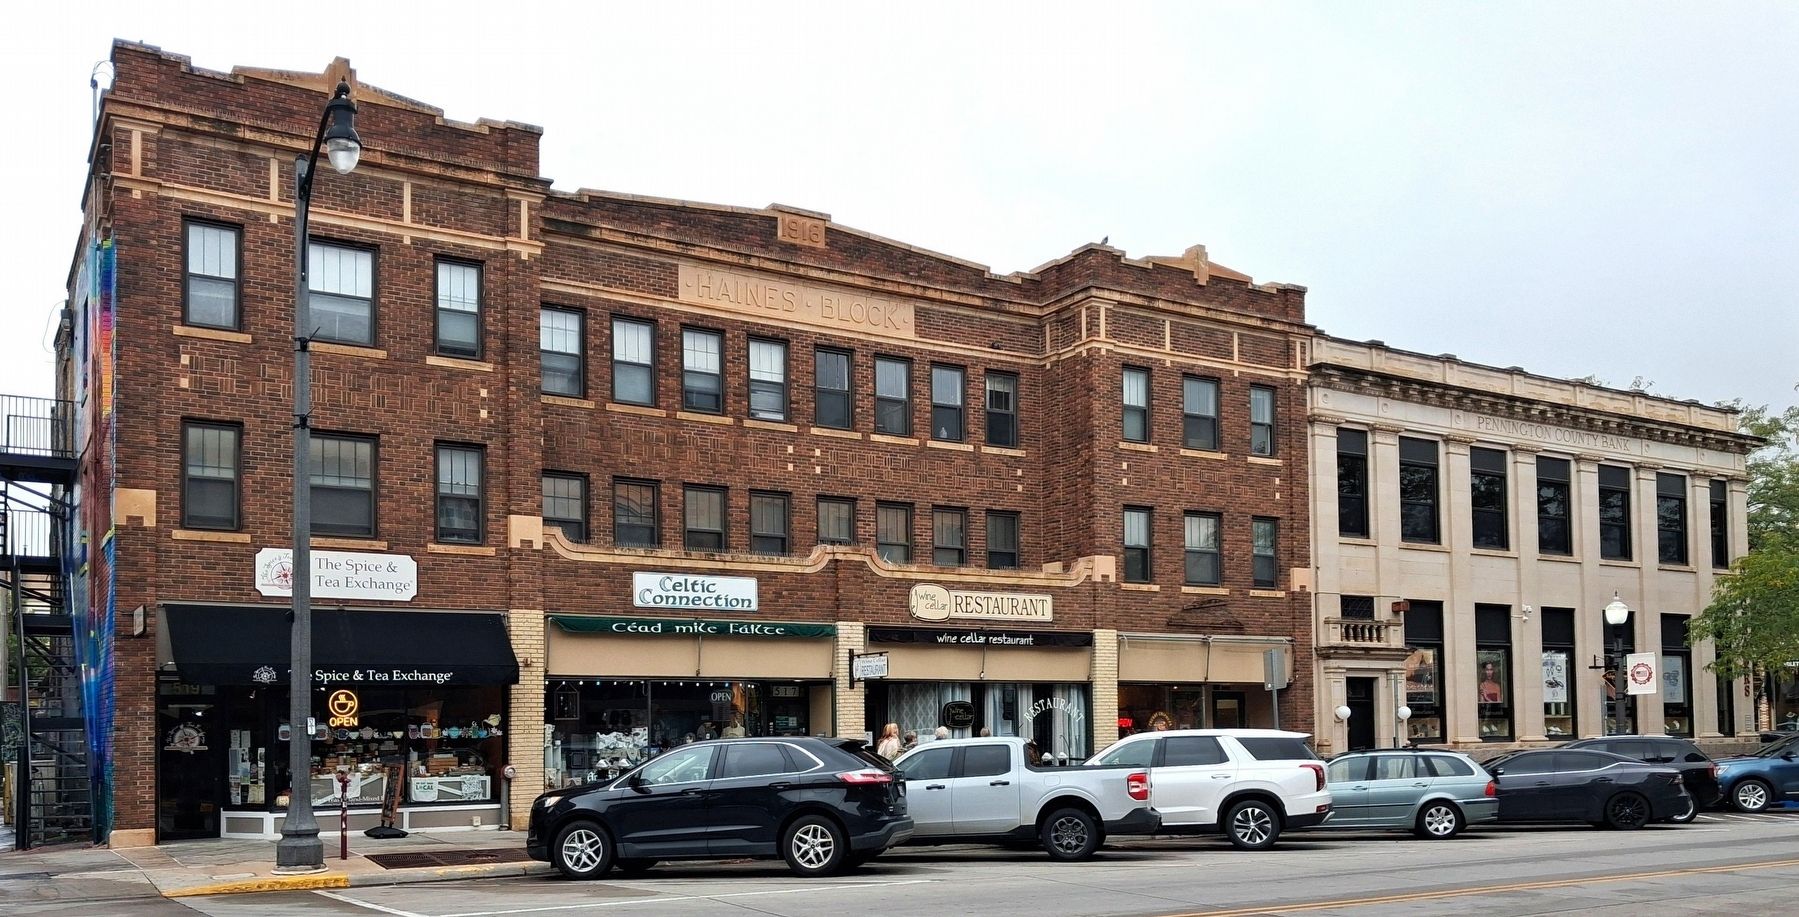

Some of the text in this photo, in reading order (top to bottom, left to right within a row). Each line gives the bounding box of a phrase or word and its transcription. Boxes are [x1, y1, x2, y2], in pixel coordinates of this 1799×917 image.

[697, 272, 901, 330] HAINES BLOCK
[1477, 416, 1552, 440] PENNINGTON
[1601, 436, 1631, 452] BANK
[315, 557, 398, 575] The Spice &
[315, 575, 340, 588] Tea
[659, 576, 717, 593] Celtic
[638, 588, 753, 608] Connection
[918, 590, 1048, 616] wine RESTAURANT
[924, 601, 948, 611] cellar
[936, 632, 1034, 645] wine cellar restaurant
[315, 670, 350, 684] Spice
[353, 670, 364, 681] &
[367, 670, 389, 681] Tea
[711, 692, 732, 701] OPEN
[775, 687, 797, 696] 517
[1023, 697, 1085, 722] RESTAURANT
[329, 717, 358, 727] OPEN
